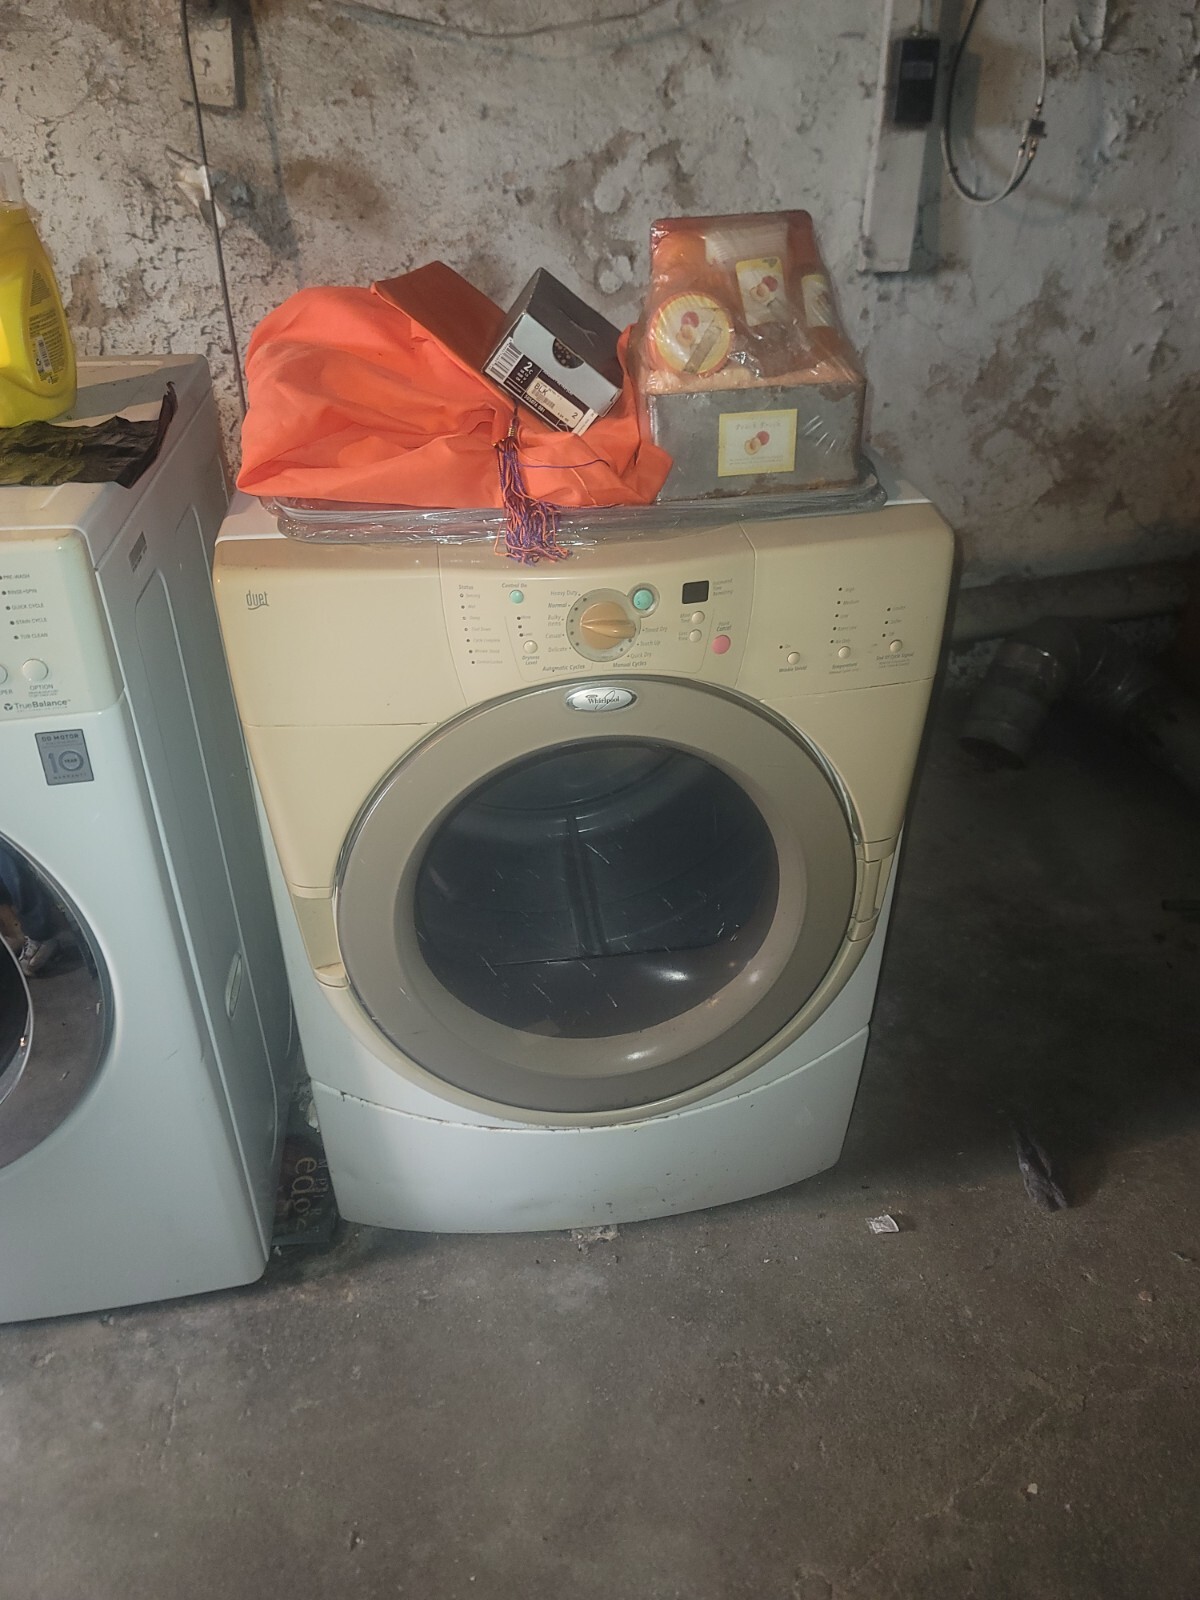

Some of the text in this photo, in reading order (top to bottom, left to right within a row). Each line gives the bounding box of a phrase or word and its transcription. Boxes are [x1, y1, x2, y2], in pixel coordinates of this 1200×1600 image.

[533, 382, 548, 396] BLK
[571, 411, 578, 419] 2
[585, 692, 620, 709] Whirlpool
[53, 733, 79, 741] MOTOR
